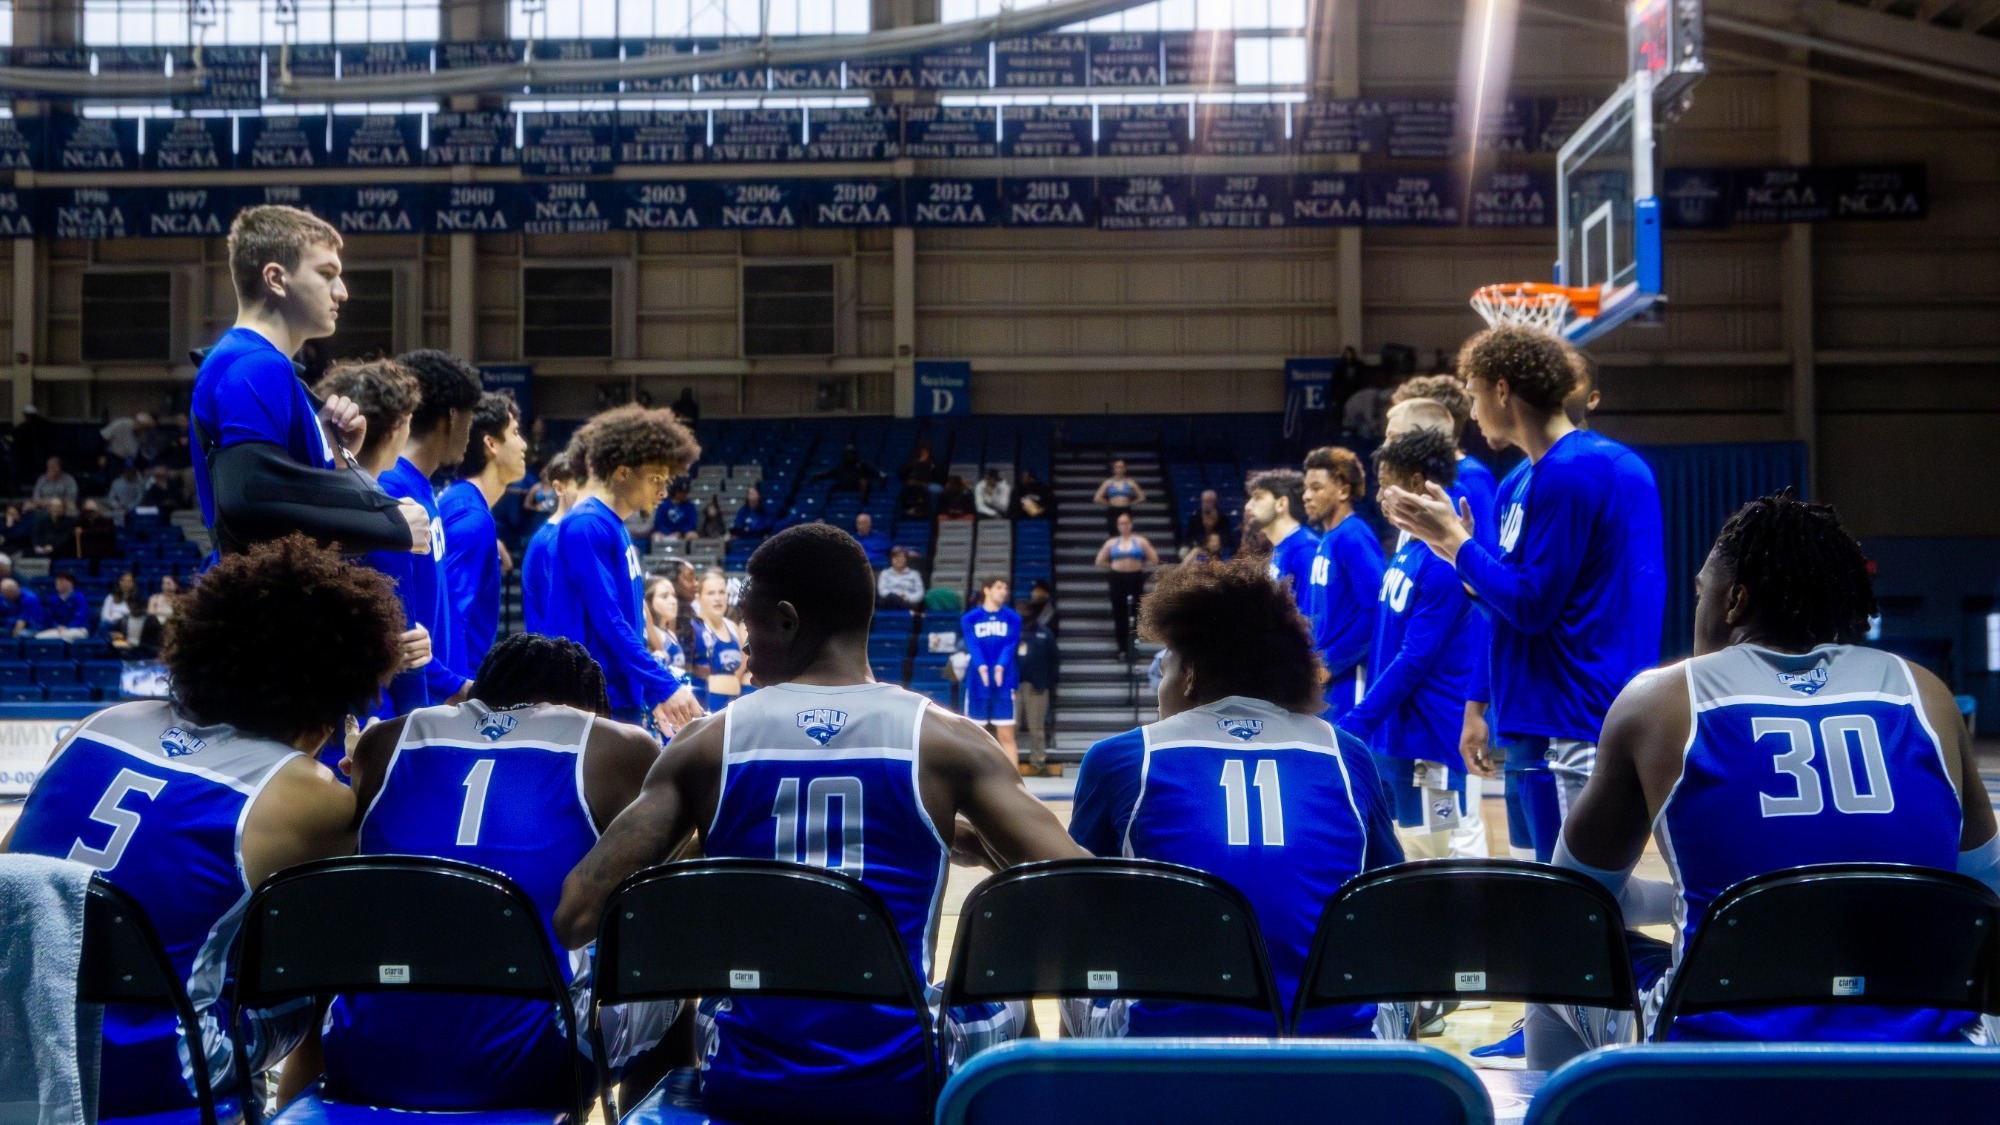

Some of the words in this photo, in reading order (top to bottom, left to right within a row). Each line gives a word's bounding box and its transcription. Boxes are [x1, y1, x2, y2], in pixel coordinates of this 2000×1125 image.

[1032, 36, 1085, 52] NCAA
[701, 70, 766, 88] NCAA
[774, 68, 839, 88] NCAA
[847, 68, 914, 87] NCAA
[920, 67, 987, 87] NCAA
[1092, 67, 1160, 85] NCAA
[943, 106, 996, 121] NCAA
[1040, 106, 1092, 120] NCAA
[63, 150, 124, 167] NCAA
[157, 149, 219, 167] NCAA
[252, 148, 314, 166] NCAA
[347, 146, 409, 164] NCAA
[713, 143, 779, 161] SWEET
[809, 142, 875, 160] SWEET
[167, 190, 208, 210] 1997
[357, 189, 399, 208] 1999
[451, 187, 495, 206] 2000
[547, 183, 586, 201] 2001
[641, 184, 687, 205] 2003
[736, 184, 781, 204] 2006
[833, 183, 878, 203] 2010
[929, 183, 973, 202] 2012
[1026, 181, 1069, 201] 2013
[1214, 193, 1268, 209] NCAA
[1385, 192, 1441, 208] NCAA
[1474, 191, 1545, 209] NCAA
[1747, 186, 1818, 205] NCAA
[535, 200, 600, 220] NCAA
[916, 203, 986, 223] NCAA
[1011, 202, 1084, 223] NCAA
[1114, 194, 1174, 213] NCAA
[1293, 198, 1362, 218] NCAA
[1837, 192, 1921, 215] NCAA
[57, 206, 125, 226] NCAA
[150, 213, 221, 234] NCAA
[341, 211, 412, 231] NCAA
[436, 209, 508, 230] NCAA
[625, 207, 699, 228] NCAA
[722, 206, 794, 227] NCAA
[818, 204, 892, 224] NCAA
[1199, 211, 1262, 227] SWEET
[932, 388, 954, 414] D
[1303, 385, 1326, 409] E
[974, 620, 1008, 638] CNU
[474, 711, 518, 731] CNU
[797, 708, 848, 728] CNU
[1217, 717, 1263, 731] CNU
[159, 726, 207, 753] CNU
[1751, 714, 1895, 818] 30
[455, 759, 496, 846] 1
[1219, 759, 1285, 846] 11
[66, 767, 168, 873] 5
[771, 776, 864, 881] 10
[734, 972, 754, 981] clarin
[1092, 973, 1112, 981] clarin
